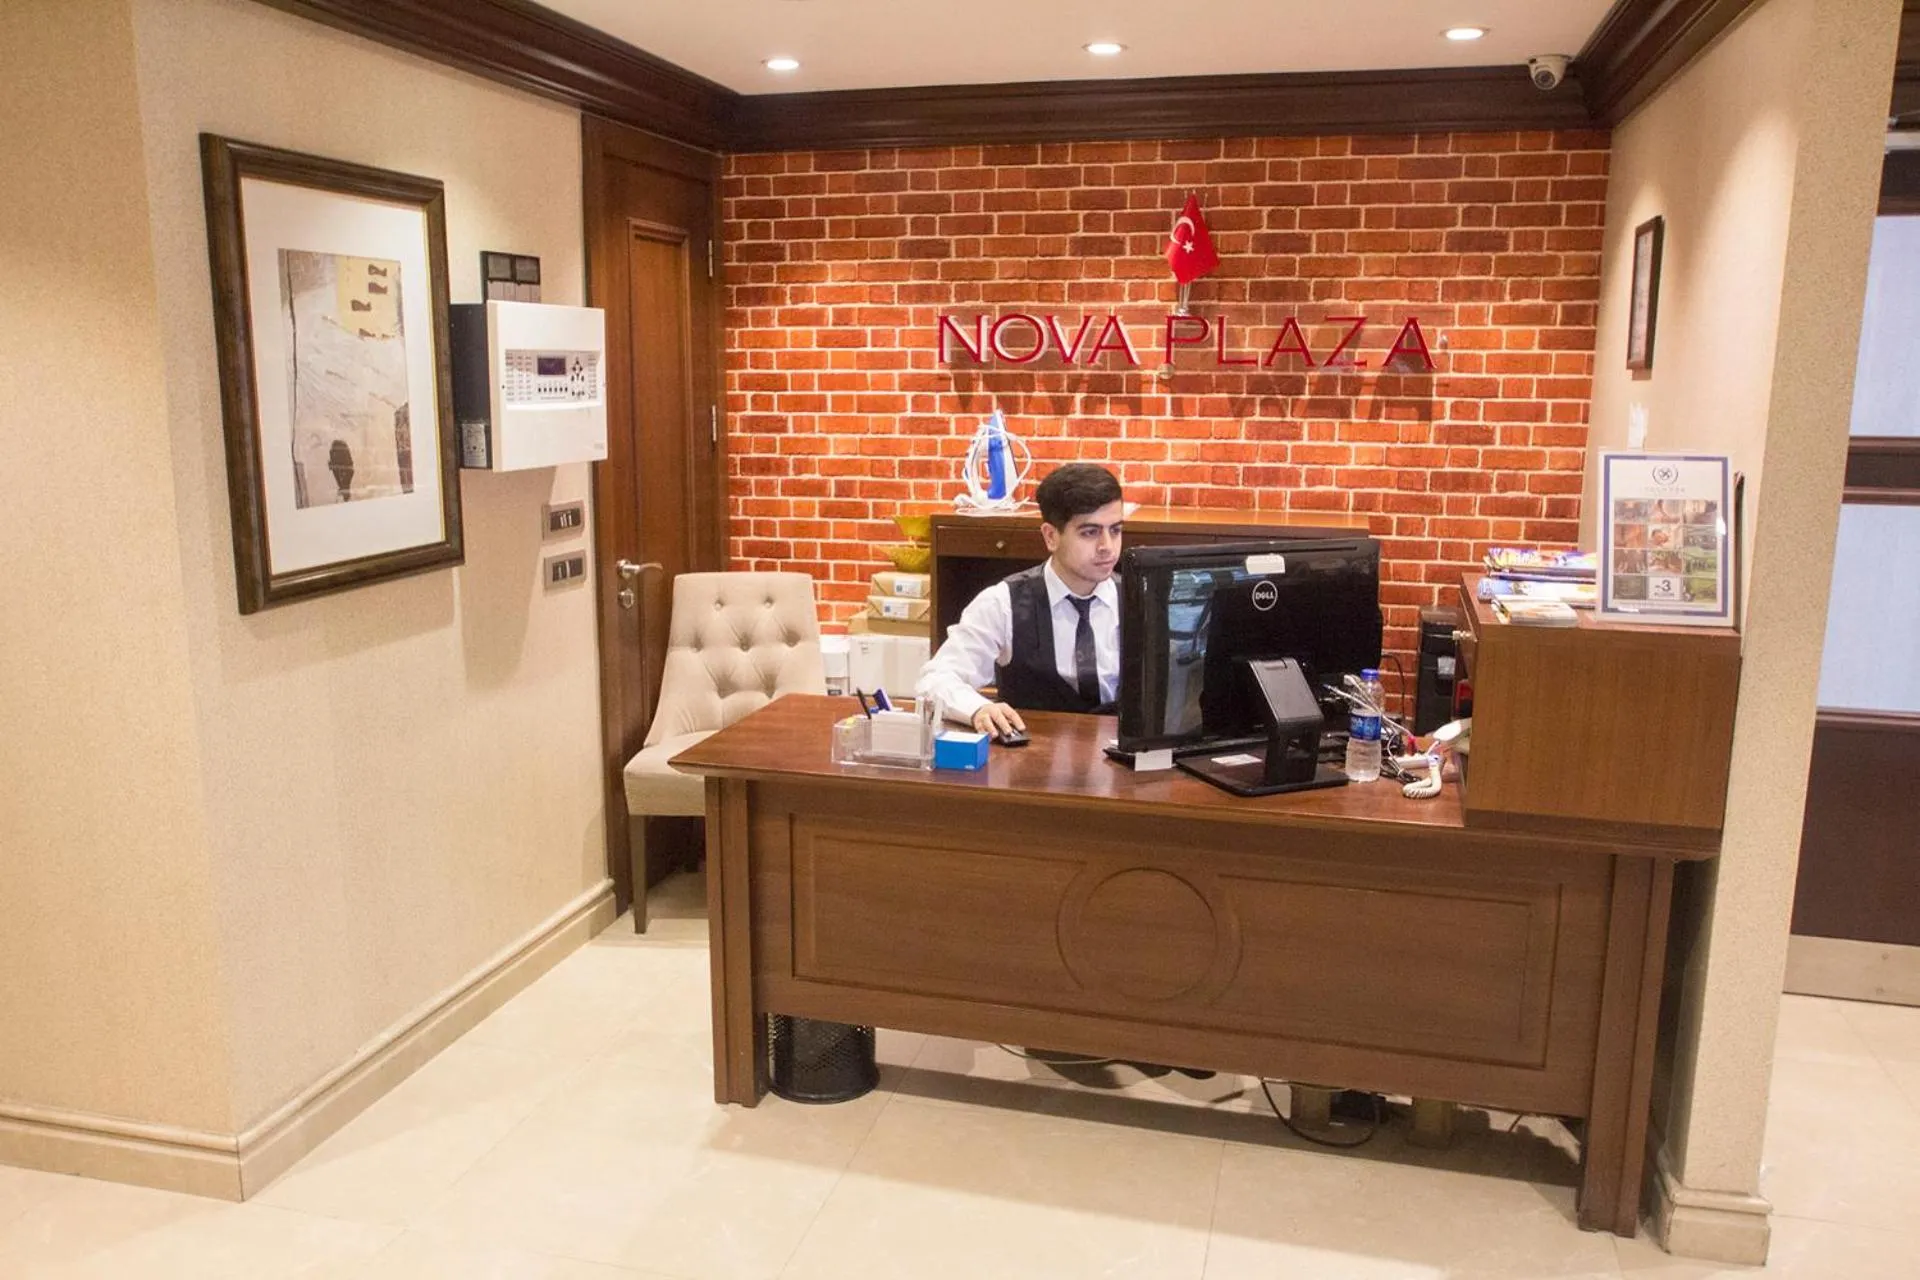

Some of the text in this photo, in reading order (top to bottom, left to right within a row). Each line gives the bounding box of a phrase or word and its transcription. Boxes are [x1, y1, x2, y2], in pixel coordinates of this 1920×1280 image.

[938, 313, 1435, 369] NOVA PLAZA
[1255, 591, 1275, 600] DELL
